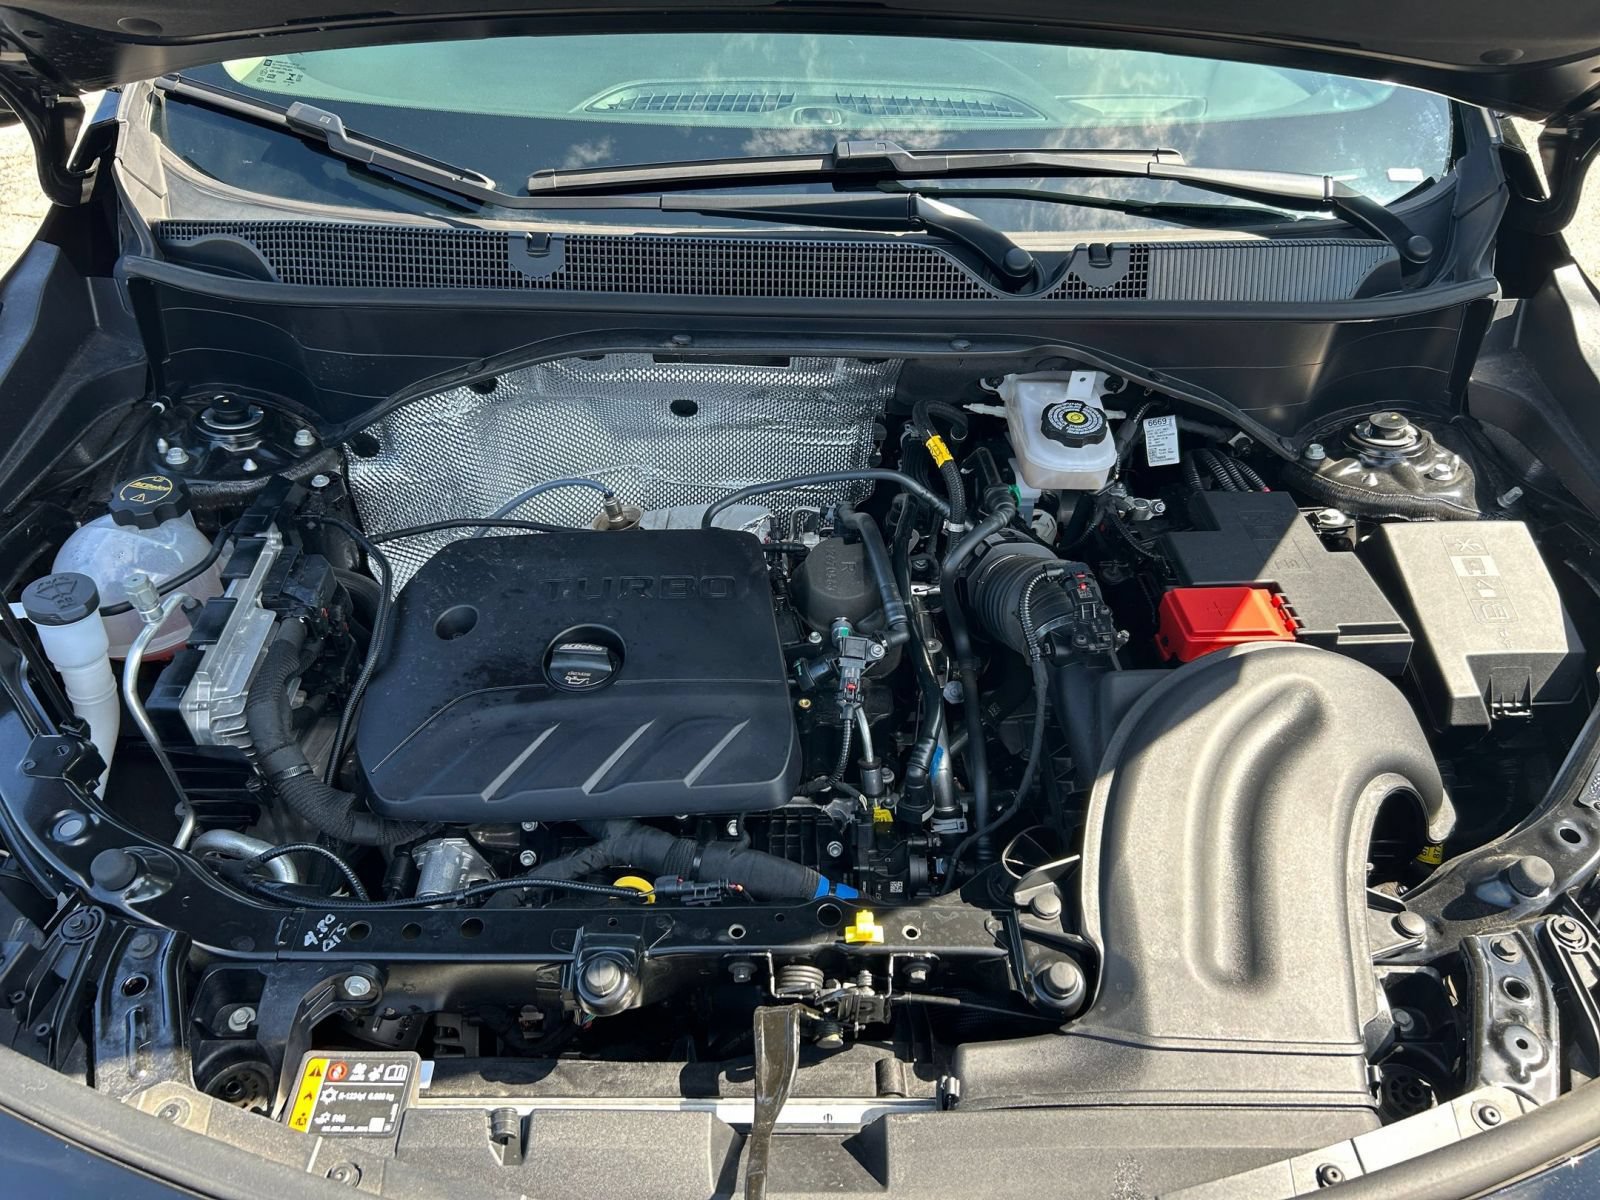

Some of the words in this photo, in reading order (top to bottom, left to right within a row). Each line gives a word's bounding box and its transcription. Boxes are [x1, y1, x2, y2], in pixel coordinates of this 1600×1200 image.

[1147, 418, 1167, 427] 6669
[537, 575, 736, 600] TURBO
[559, 643, 603, 651] ACDelco
